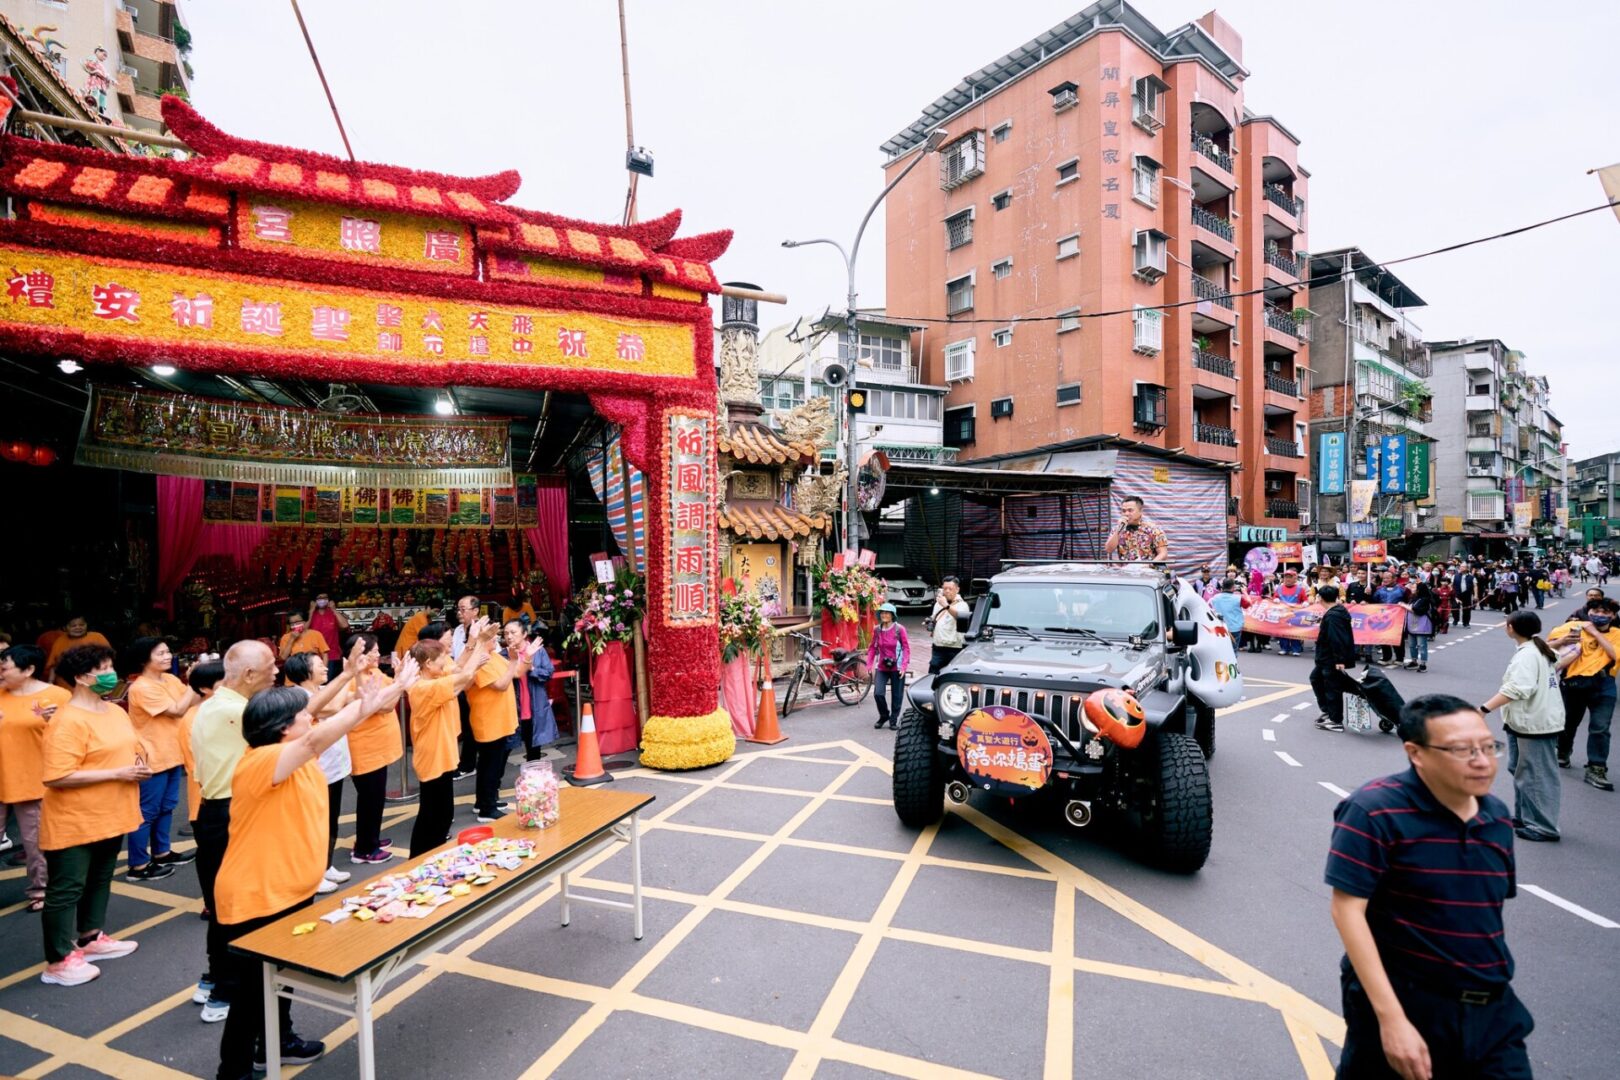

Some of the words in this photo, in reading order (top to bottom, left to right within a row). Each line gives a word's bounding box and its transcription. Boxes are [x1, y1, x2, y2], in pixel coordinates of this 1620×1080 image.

[355, 486, 378, 507] 佛
[391, 486, 415, 507] 佛
[675, 426, 705, 614] 祈風調雨順
